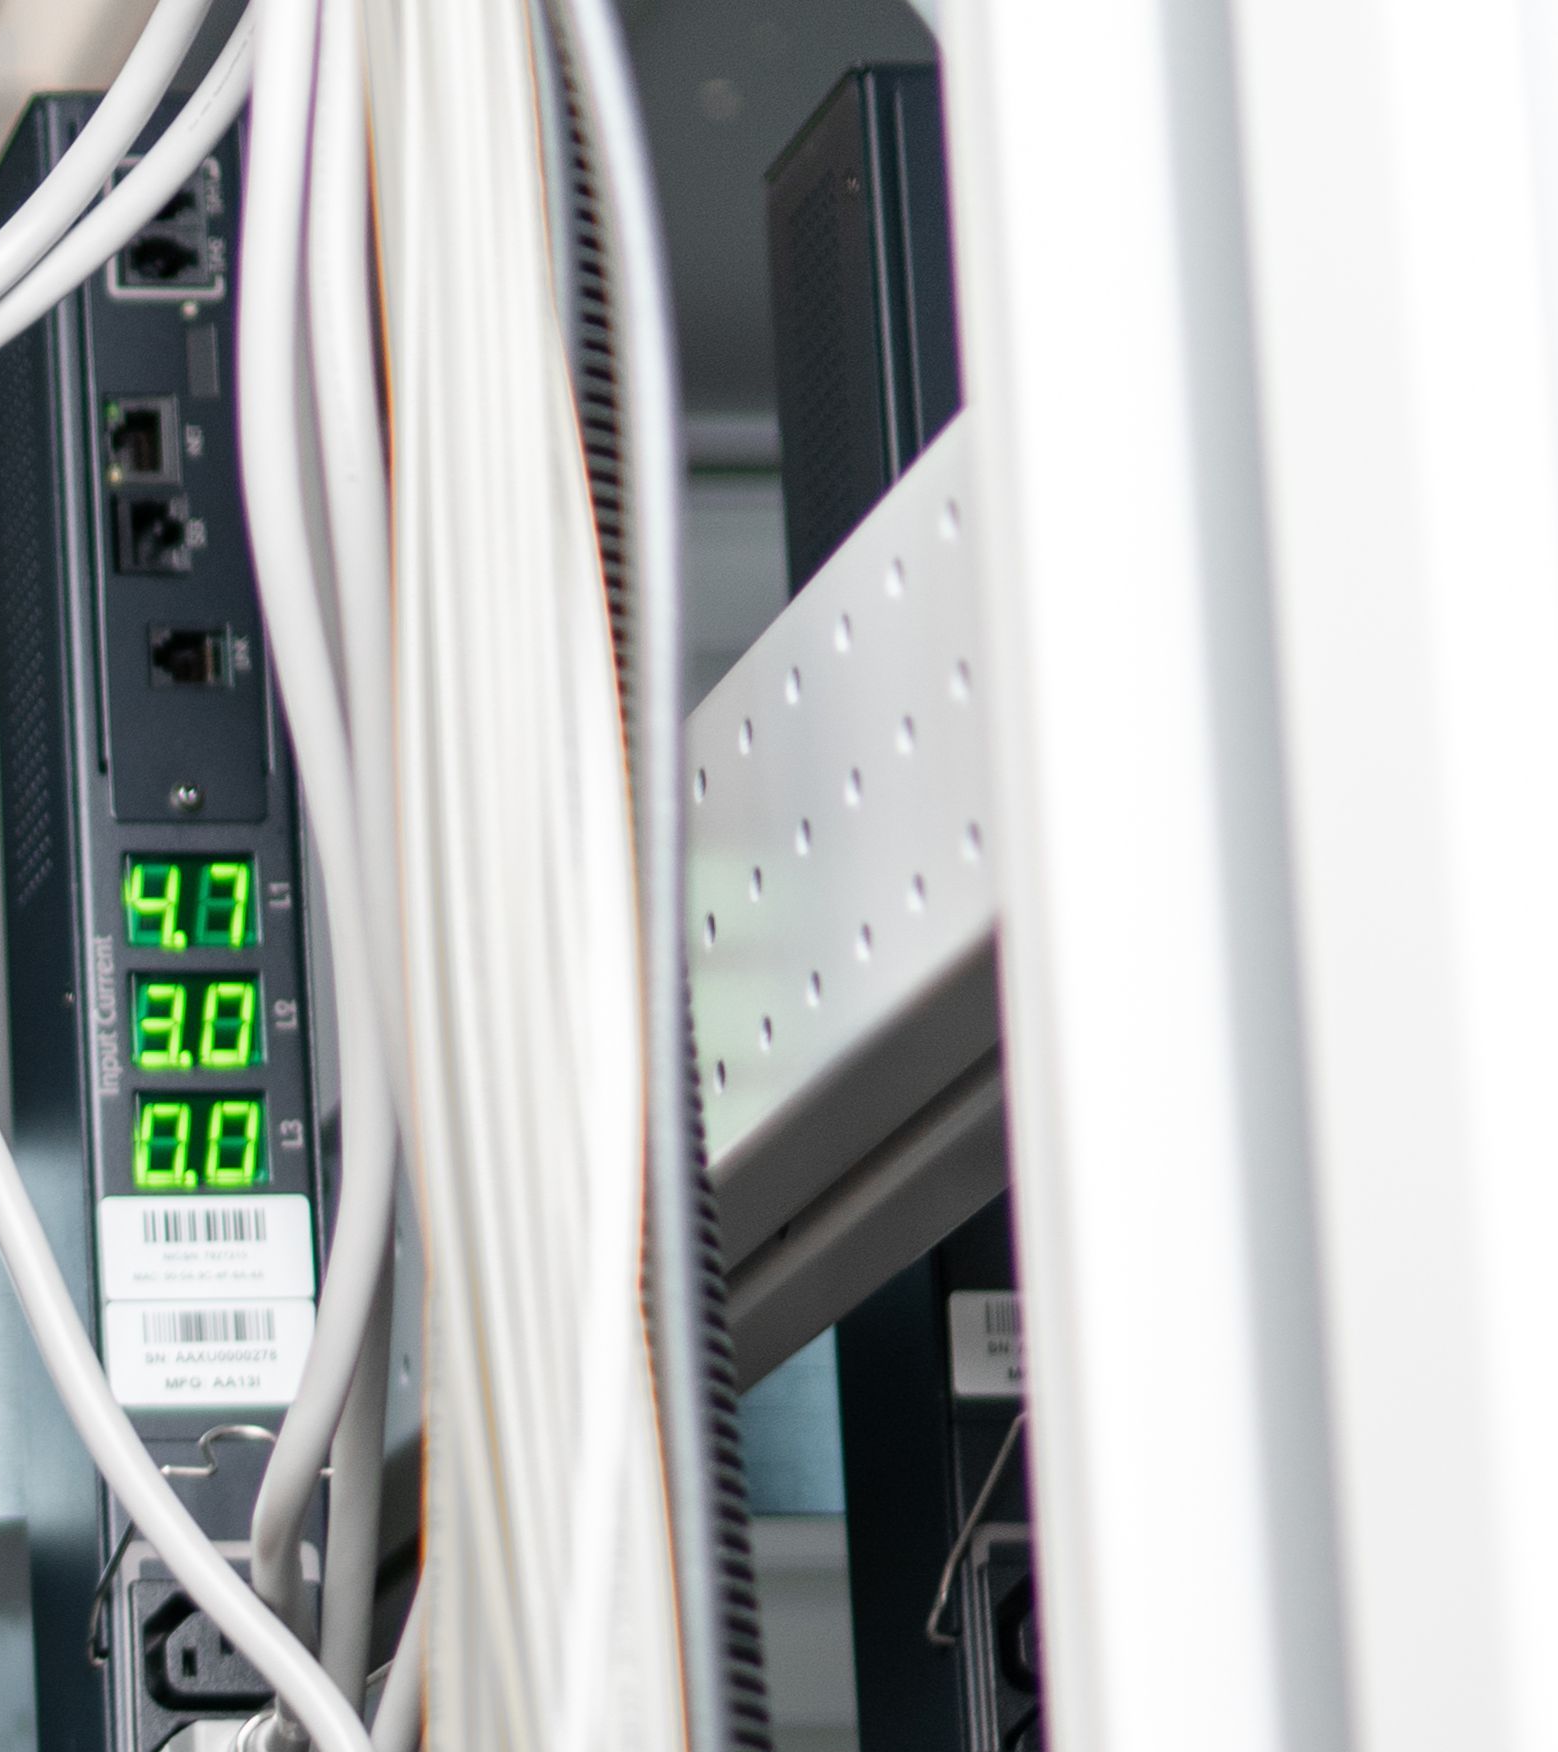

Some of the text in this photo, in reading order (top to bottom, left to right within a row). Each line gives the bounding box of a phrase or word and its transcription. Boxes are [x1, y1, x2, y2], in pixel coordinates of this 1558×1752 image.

[127, 863, 248, 948] 4.7
[269, 881, 291, 909] L1
[93, 934, 121, 1095] Input Current
[140, 982, 254, 1069] 3.0
[275, 1000, 297, 1031] L2
[135, 1101, 261, 1189] 0.0
[282, 1119, 304, 1149] L3
